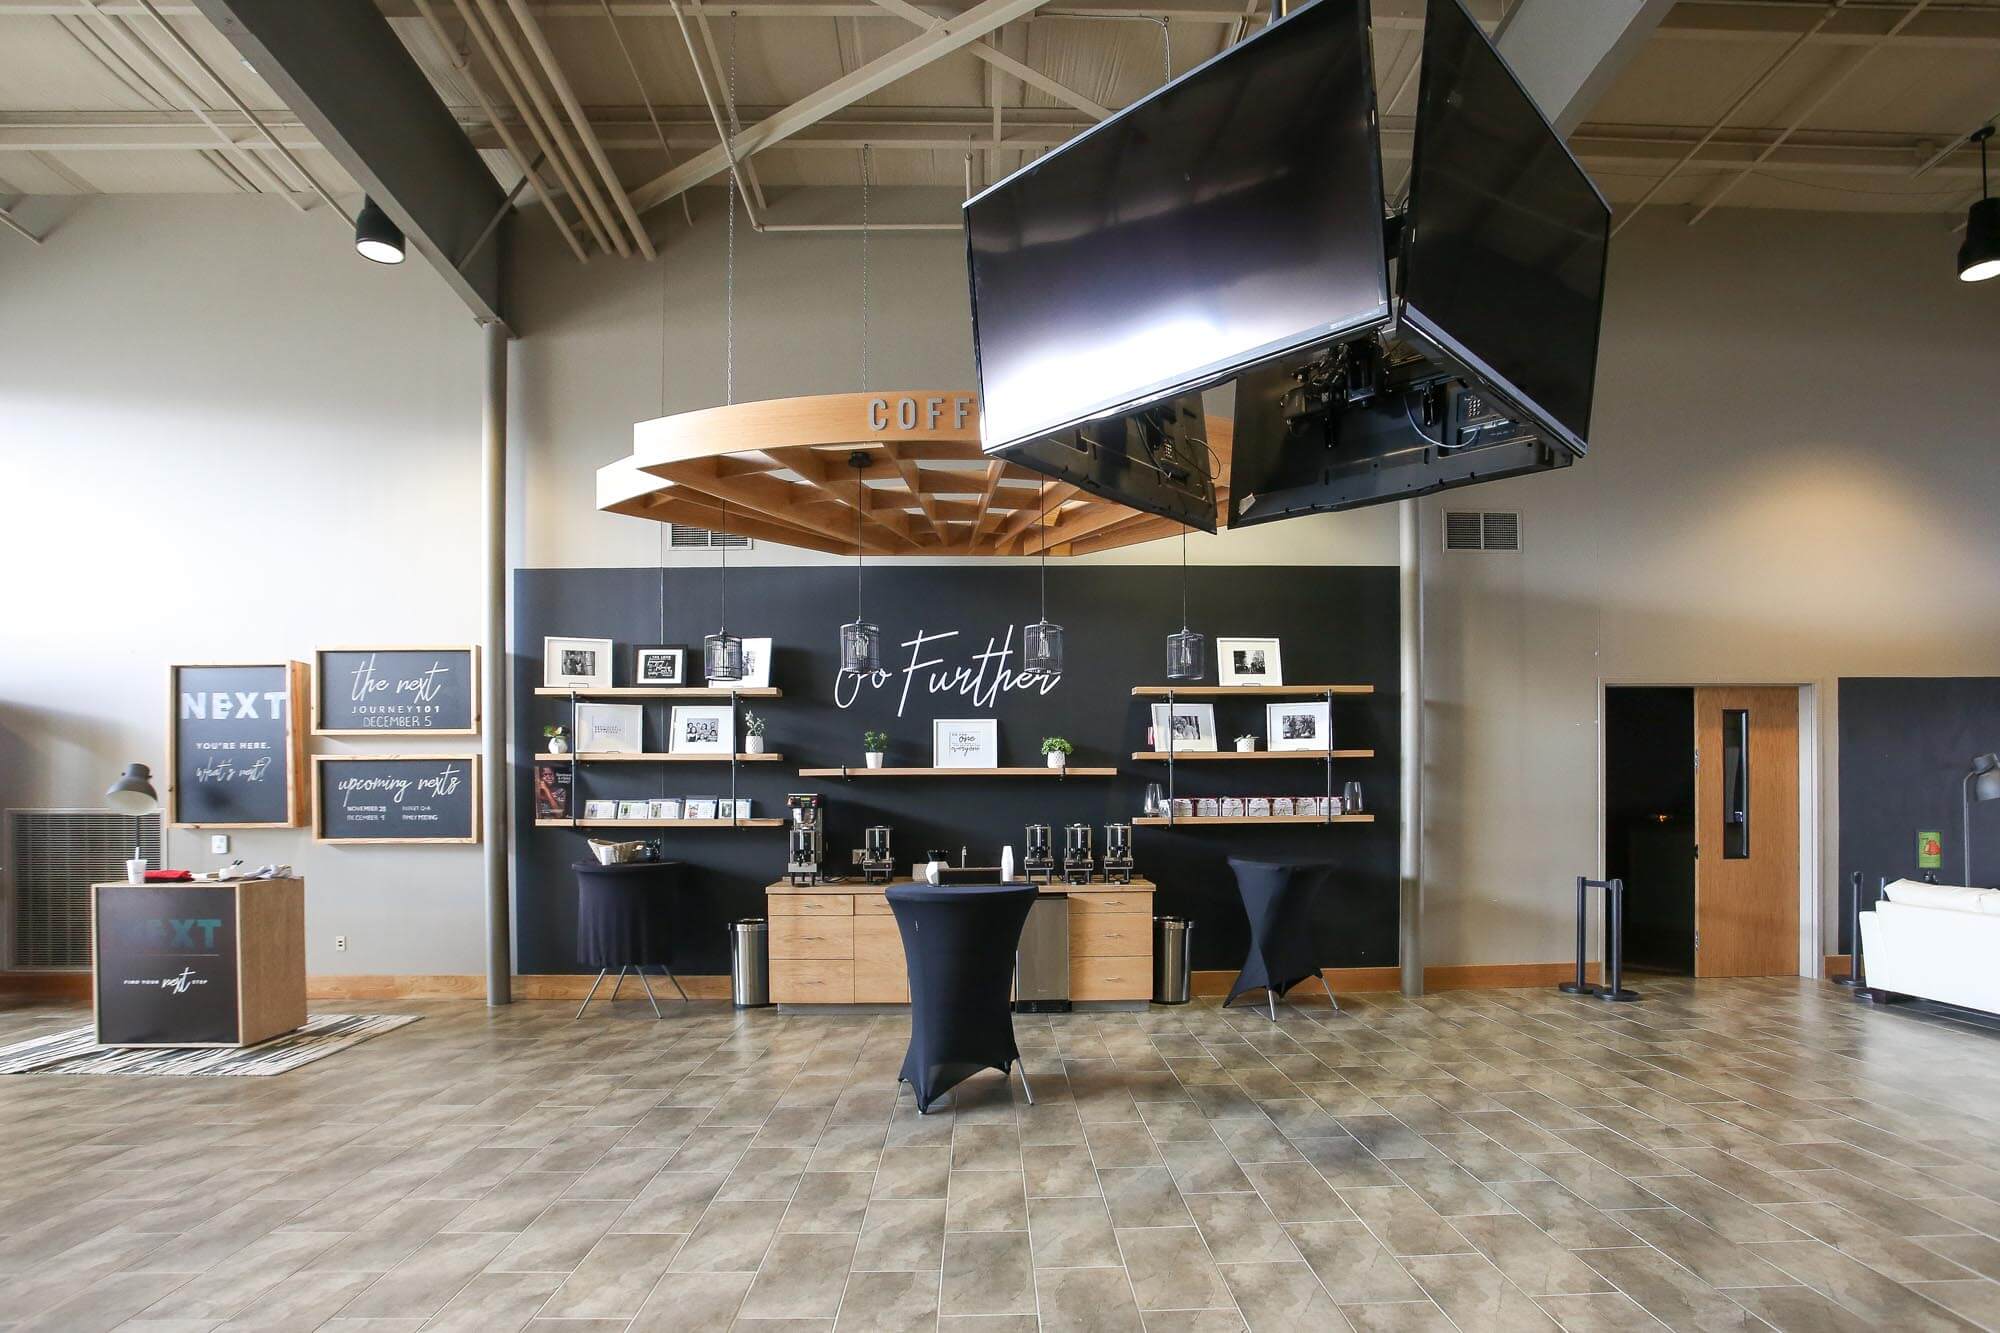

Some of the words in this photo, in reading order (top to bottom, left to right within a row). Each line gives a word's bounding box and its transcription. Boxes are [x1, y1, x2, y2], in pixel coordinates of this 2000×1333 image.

[352, 653, 389, 701] the
[396, 660, 449, 704] next
[898, 624, 1061, 717] Further
[181, 692, 286, 719] NEXT
[363, 715, 420, 727] DECEMBER
[424, 715, 432, 727] 5
[338, 776, 412, 807] upcoming
[418, 764, 461, 797] nexts
[161, 967, 196, 994] next
